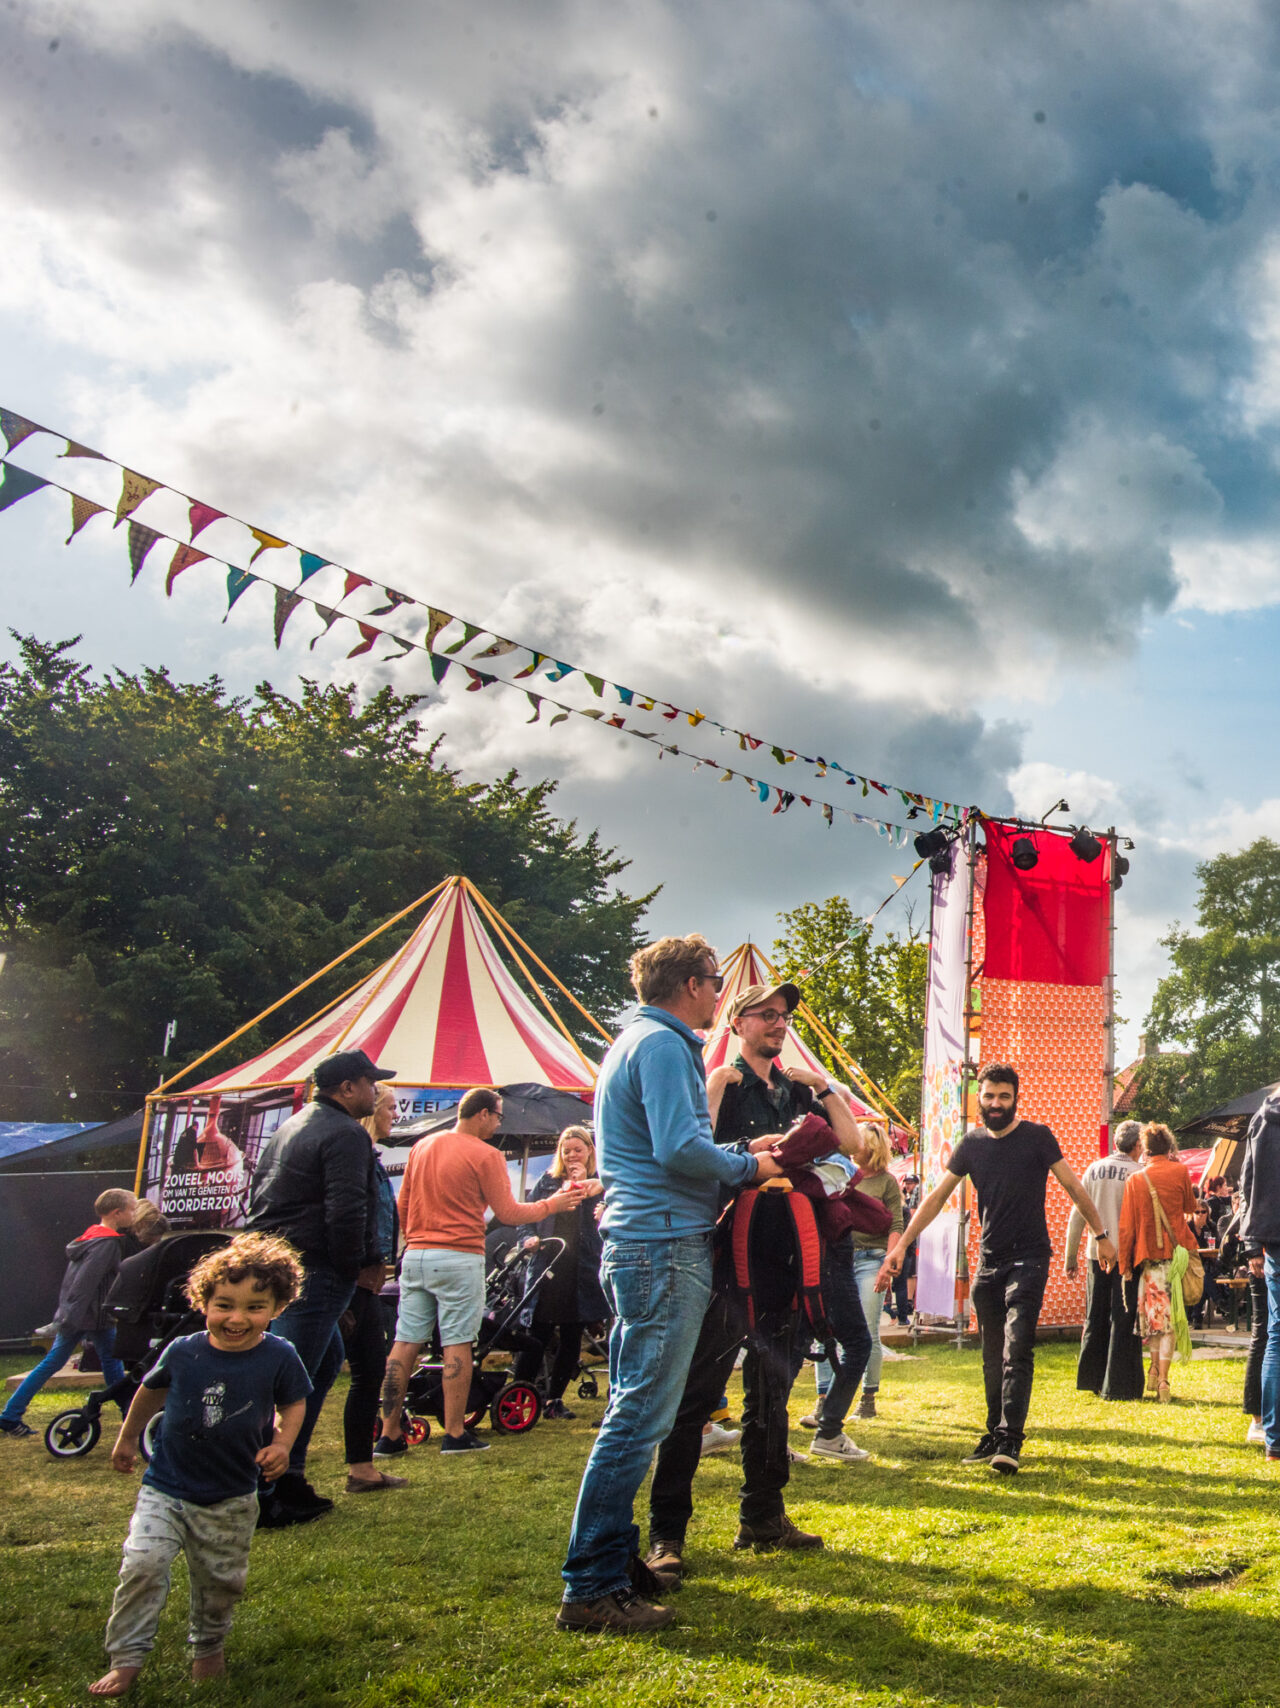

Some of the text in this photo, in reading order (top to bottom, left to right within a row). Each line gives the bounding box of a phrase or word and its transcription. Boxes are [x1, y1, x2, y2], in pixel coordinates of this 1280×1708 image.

[164, 1168, 245, 1188] ZOVEEL MOOIS
[162, 1189, 174, 1199] OM
[174, 1187, 188, 1198] VAN
[188, 1186, 197, 1197] TE
[197, 1184, 230, 1196] GENIETEN
[160, 1195, 241, 1214] NOORDERZON
